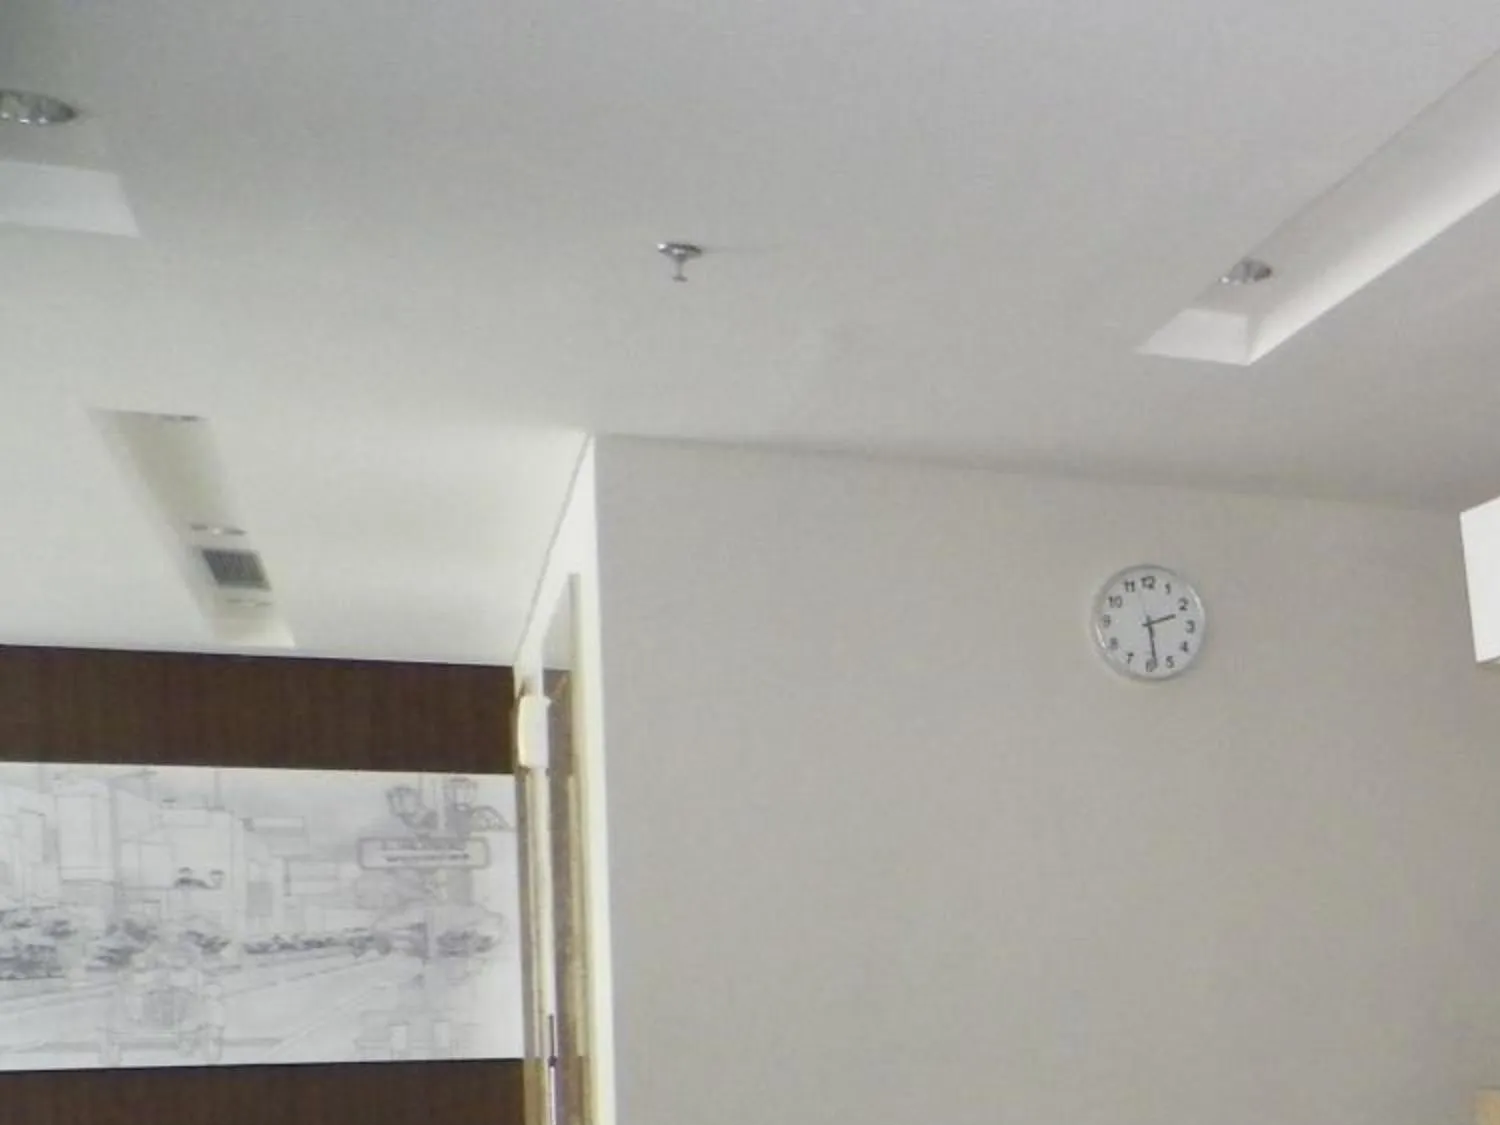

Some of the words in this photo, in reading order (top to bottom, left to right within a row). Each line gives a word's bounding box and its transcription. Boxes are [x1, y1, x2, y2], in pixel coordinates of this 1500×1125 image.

[1124, 580, 1136, 593] 11
[1140, 575, 1156, 590] 12
[1164, 582, 1171, 595] 1
[1108, 595, 1123, 609] 10
[1178, 597, 1189, 611] 2
[1102, 614, 1111, 628] 9
[1185, 619, 1196, 634] 3
[1179, 640, 1189, 653] 4
[1126, 652, 1134, 665] 7
[1165, 655, 1175, 669] 5
